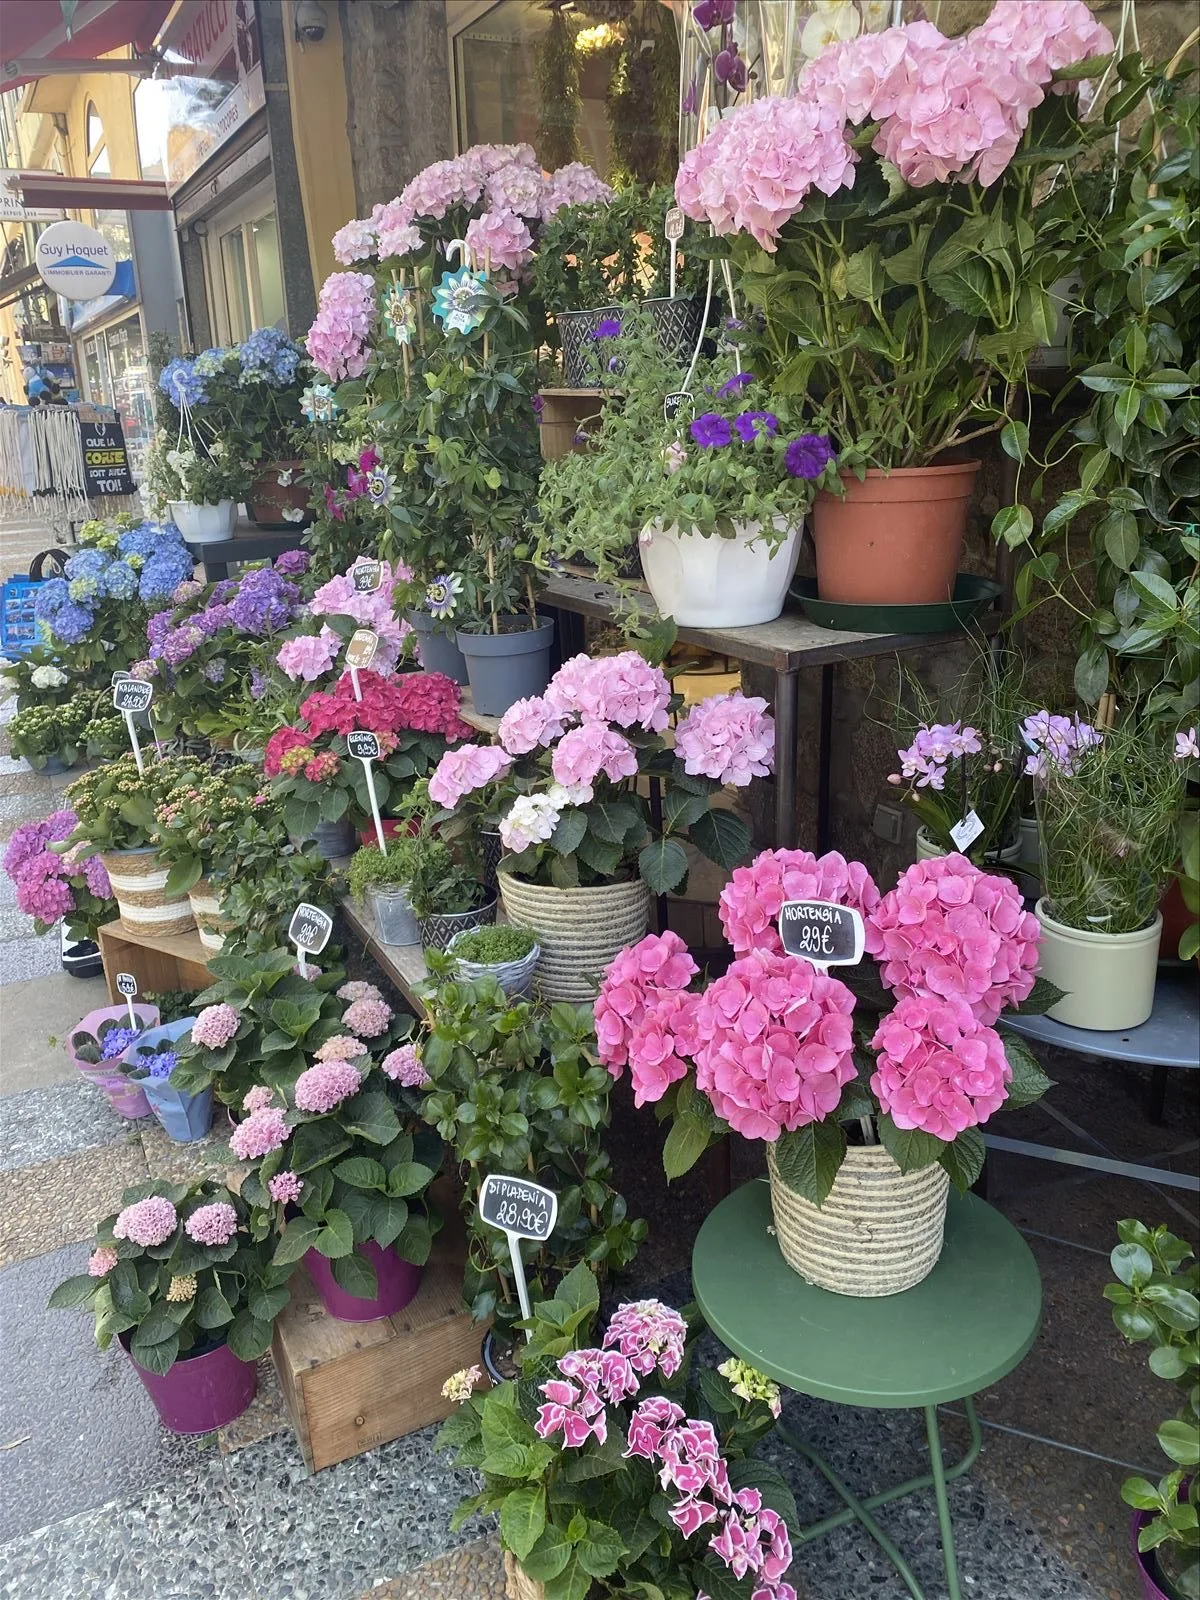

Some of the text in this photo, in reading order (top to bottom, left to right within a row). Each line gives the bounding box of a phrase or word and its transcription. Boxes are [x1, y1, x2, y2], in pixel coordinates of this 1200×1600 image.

[40, 243, 109, 257] Guy Hoquet
[86, 438, 106, 447] QUE
[85, 451, 125, 465] CORSE
[89, 468, 127, 478] SOIT AVEC
[799, 924, 835, 955] 29€
[496, 1200, 549, 1235] 28,90€
